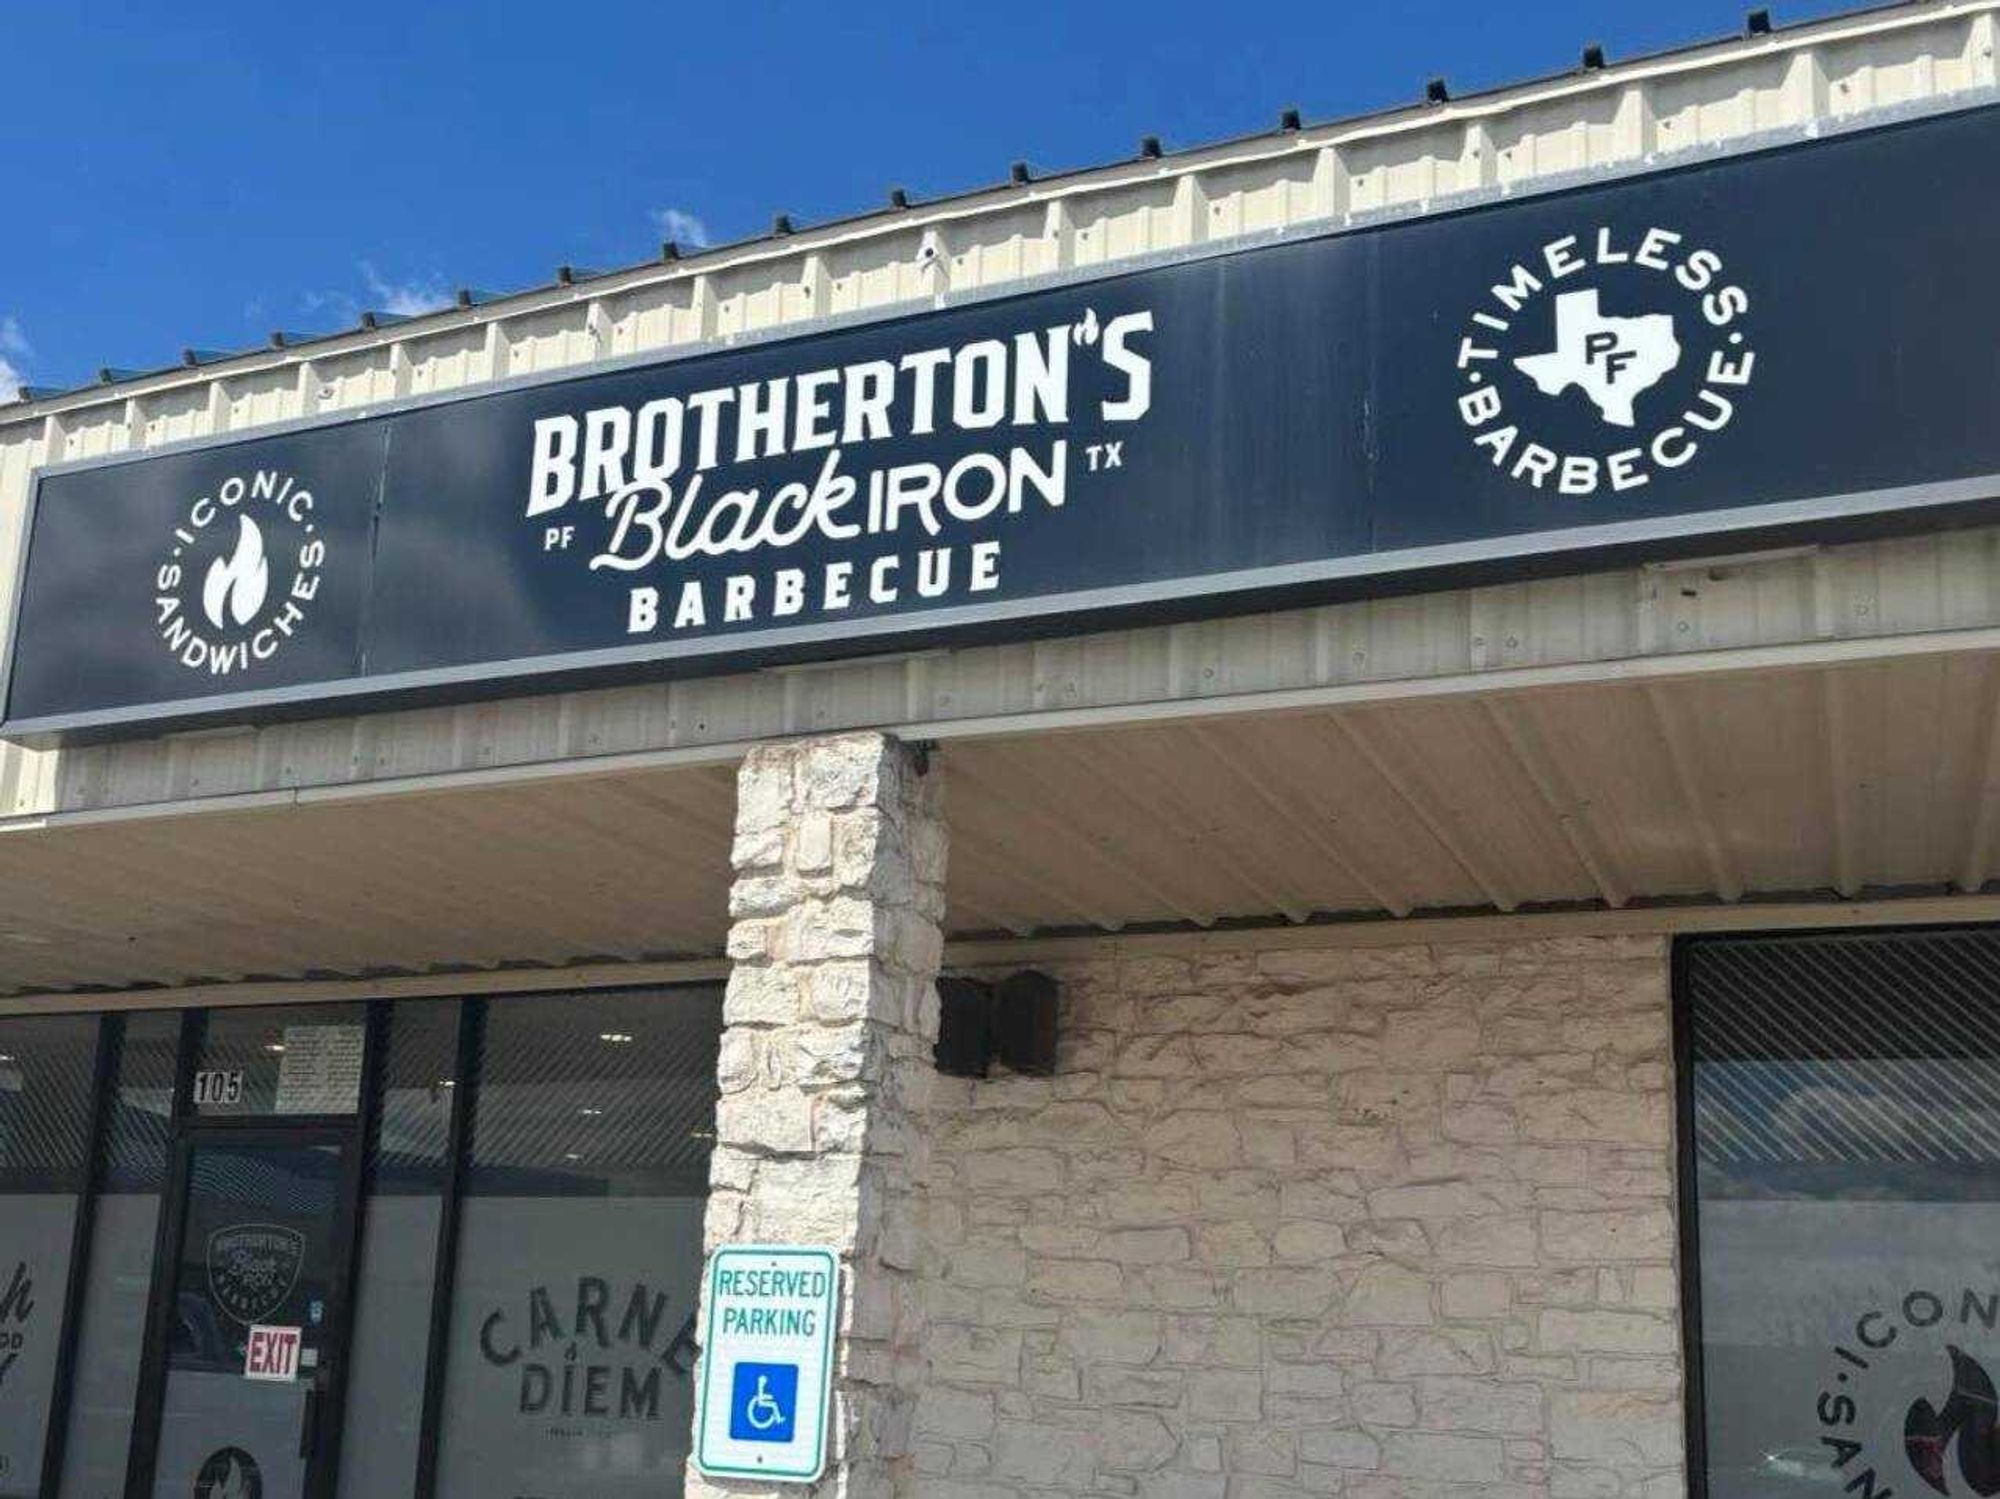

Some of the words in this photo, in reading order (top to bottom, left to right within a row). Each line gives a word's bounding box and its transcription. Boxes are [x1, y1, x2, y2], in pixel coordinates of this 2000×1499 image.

[1457, 227, 1748, 368] TIMELESS
[526, 309, 1154, 517] BROTHERTON'S
[1458, 351, 1755, 494] BARBECUE
[1085, 441, 1124, 472] TX
[174, 470, 314, 546] ICONIC
[543, 526, 575, 551] PF
[589, 450, 861, 571] Black
[867, 440, 1066, 537] IRON
[156, 539, 325, 675] SANDWICHES
[626, 541, 1000, 633] BARBECUE
[200, 1072, 239, 1101] 105
[718, 1270, 826, 1298] RESERVED
[722, 1307, 816, 1337] PARKING
[249, 1332, 298, 1374] EXIT
